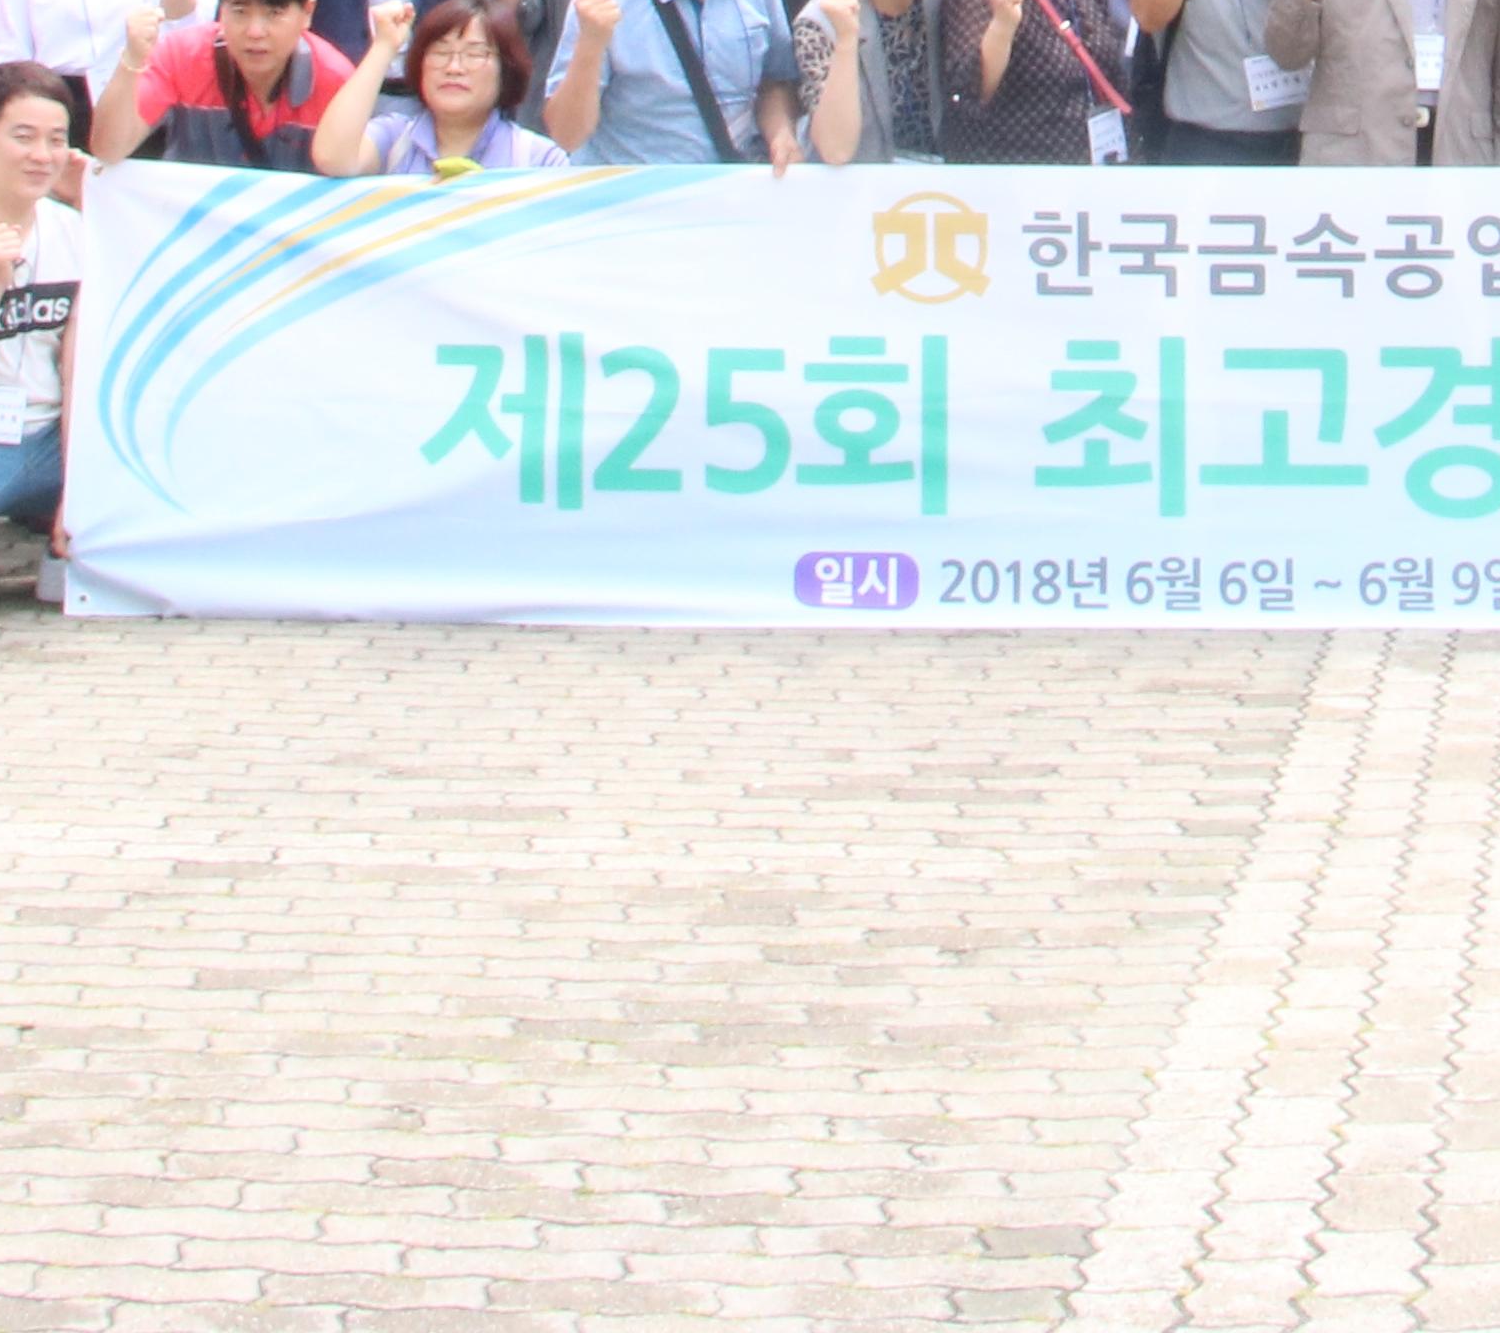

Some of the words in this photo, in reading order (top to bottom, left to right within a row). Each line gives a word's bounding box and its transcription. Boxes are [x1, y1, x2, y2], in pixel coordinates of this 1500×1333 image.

[419, 332, 949, 518] 제25회
[816, 557, 897, 605] 일시
[941, 558, 1109, 608] 2018년
[1127, 557, 1201, 610] 6월
[1220, 559, 1293, 611] 6일
[1360, 558, 1433, 610] 6월
